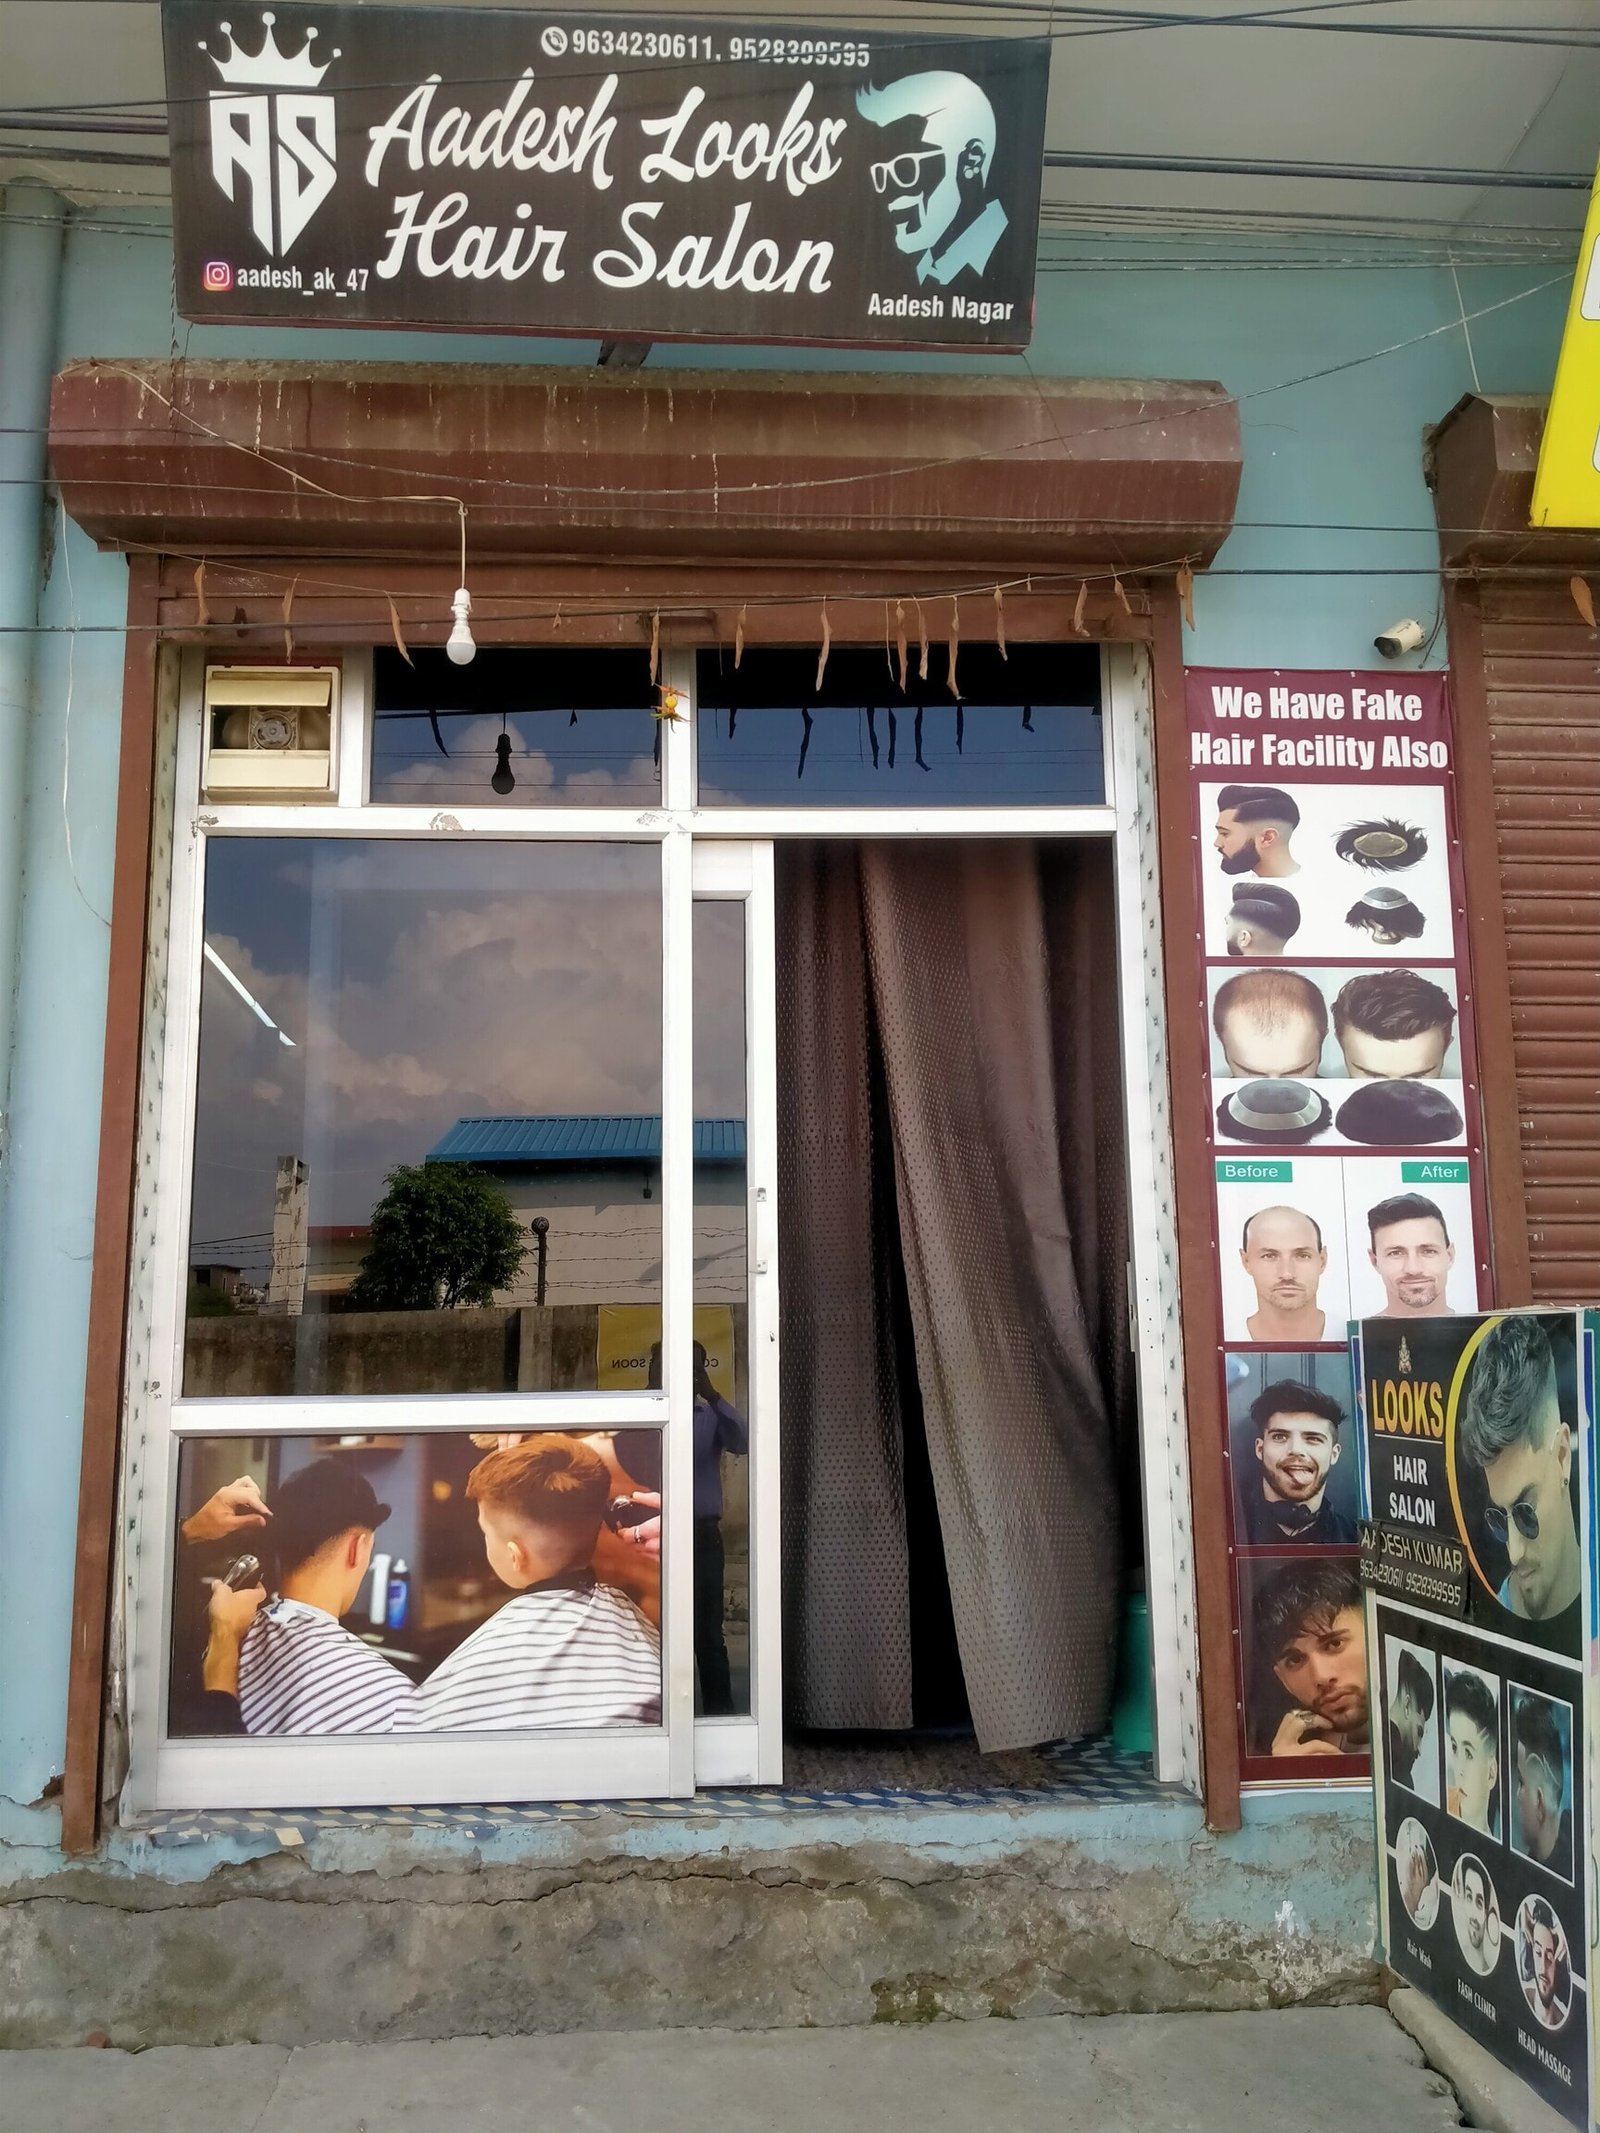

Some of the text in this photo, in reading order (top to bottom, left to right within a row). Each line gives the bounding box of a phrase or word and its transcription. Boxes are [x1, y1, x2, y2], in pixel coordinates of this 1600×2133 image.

[364, 67, 848, 196] Aadesh Looks
[376, 190, 835, 293] Hair Salon
[237, 265, 369, 297] aadesh_ak_47
[867, 293, 1014, 325] Aadesh Nagar
[1211, 686, 1422, 721] We Have Fake
[1191, 732, 1448, 770] Hair Facility Also
[1225, 1165, 1278, 1178] Before
[1421, 1165, 1459, 1178] After
[1372, 1379, 1444, 1438] LOOKS
[1393, 1454, 1428, 1486] HAIR
[1389, 1494, 1436, 1527] SALON
[1412, 1539, 1463, 1575] KUMAR
[1405, 1571, 1461, 1606] 9528399595
[1517, 2027, 1572, 2087] HEAD MASSAGE
